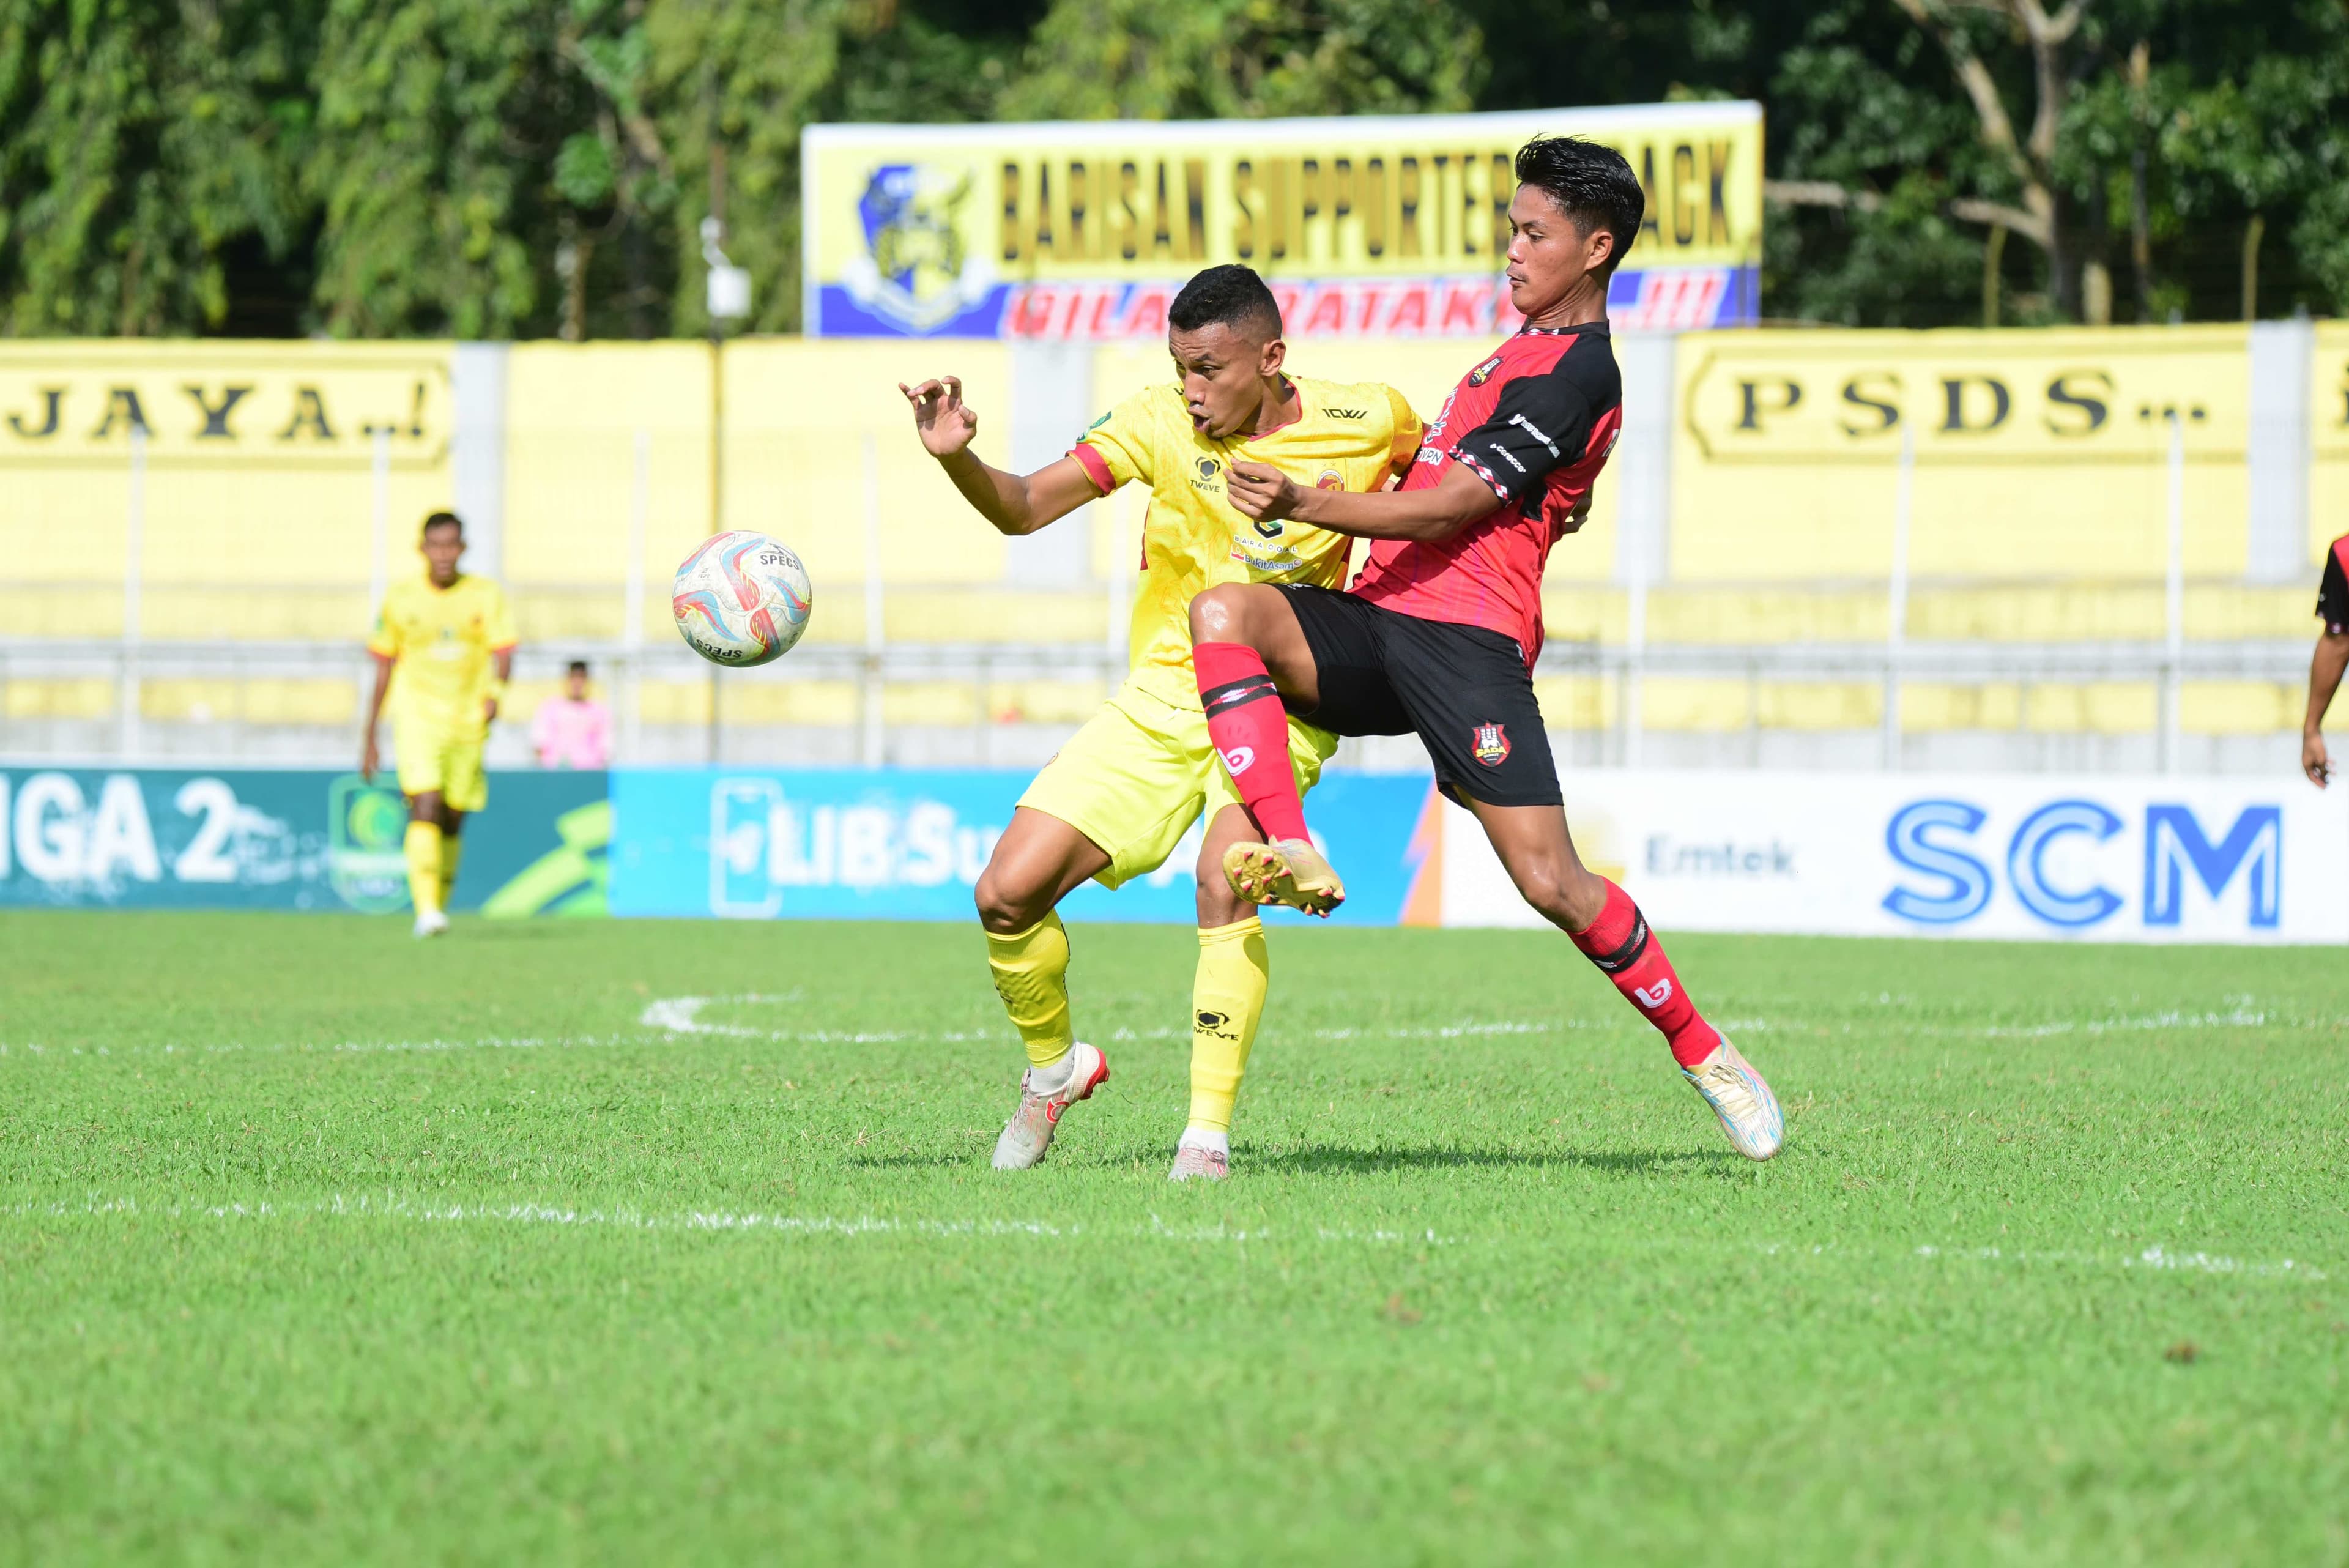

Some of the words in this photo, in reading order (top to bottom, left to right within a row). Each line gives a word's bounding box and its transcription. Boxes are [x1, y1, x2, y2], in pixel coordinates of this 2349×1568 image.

[998, 157, 1208, 261] BARISAN
[1190, 479, 1220, 492] TWEVE
[1234, 535, 1263, 548] BARA
[1268, 544, 1297, 552] COAL
[760, 554, 800, 570] SPECS
[696, 638, 743, 658] SPECS
[1475, 746, 1507, 758] SADA
[173, 775, 240, 883] 2
[1881, 799, 2280, 927] SCM
